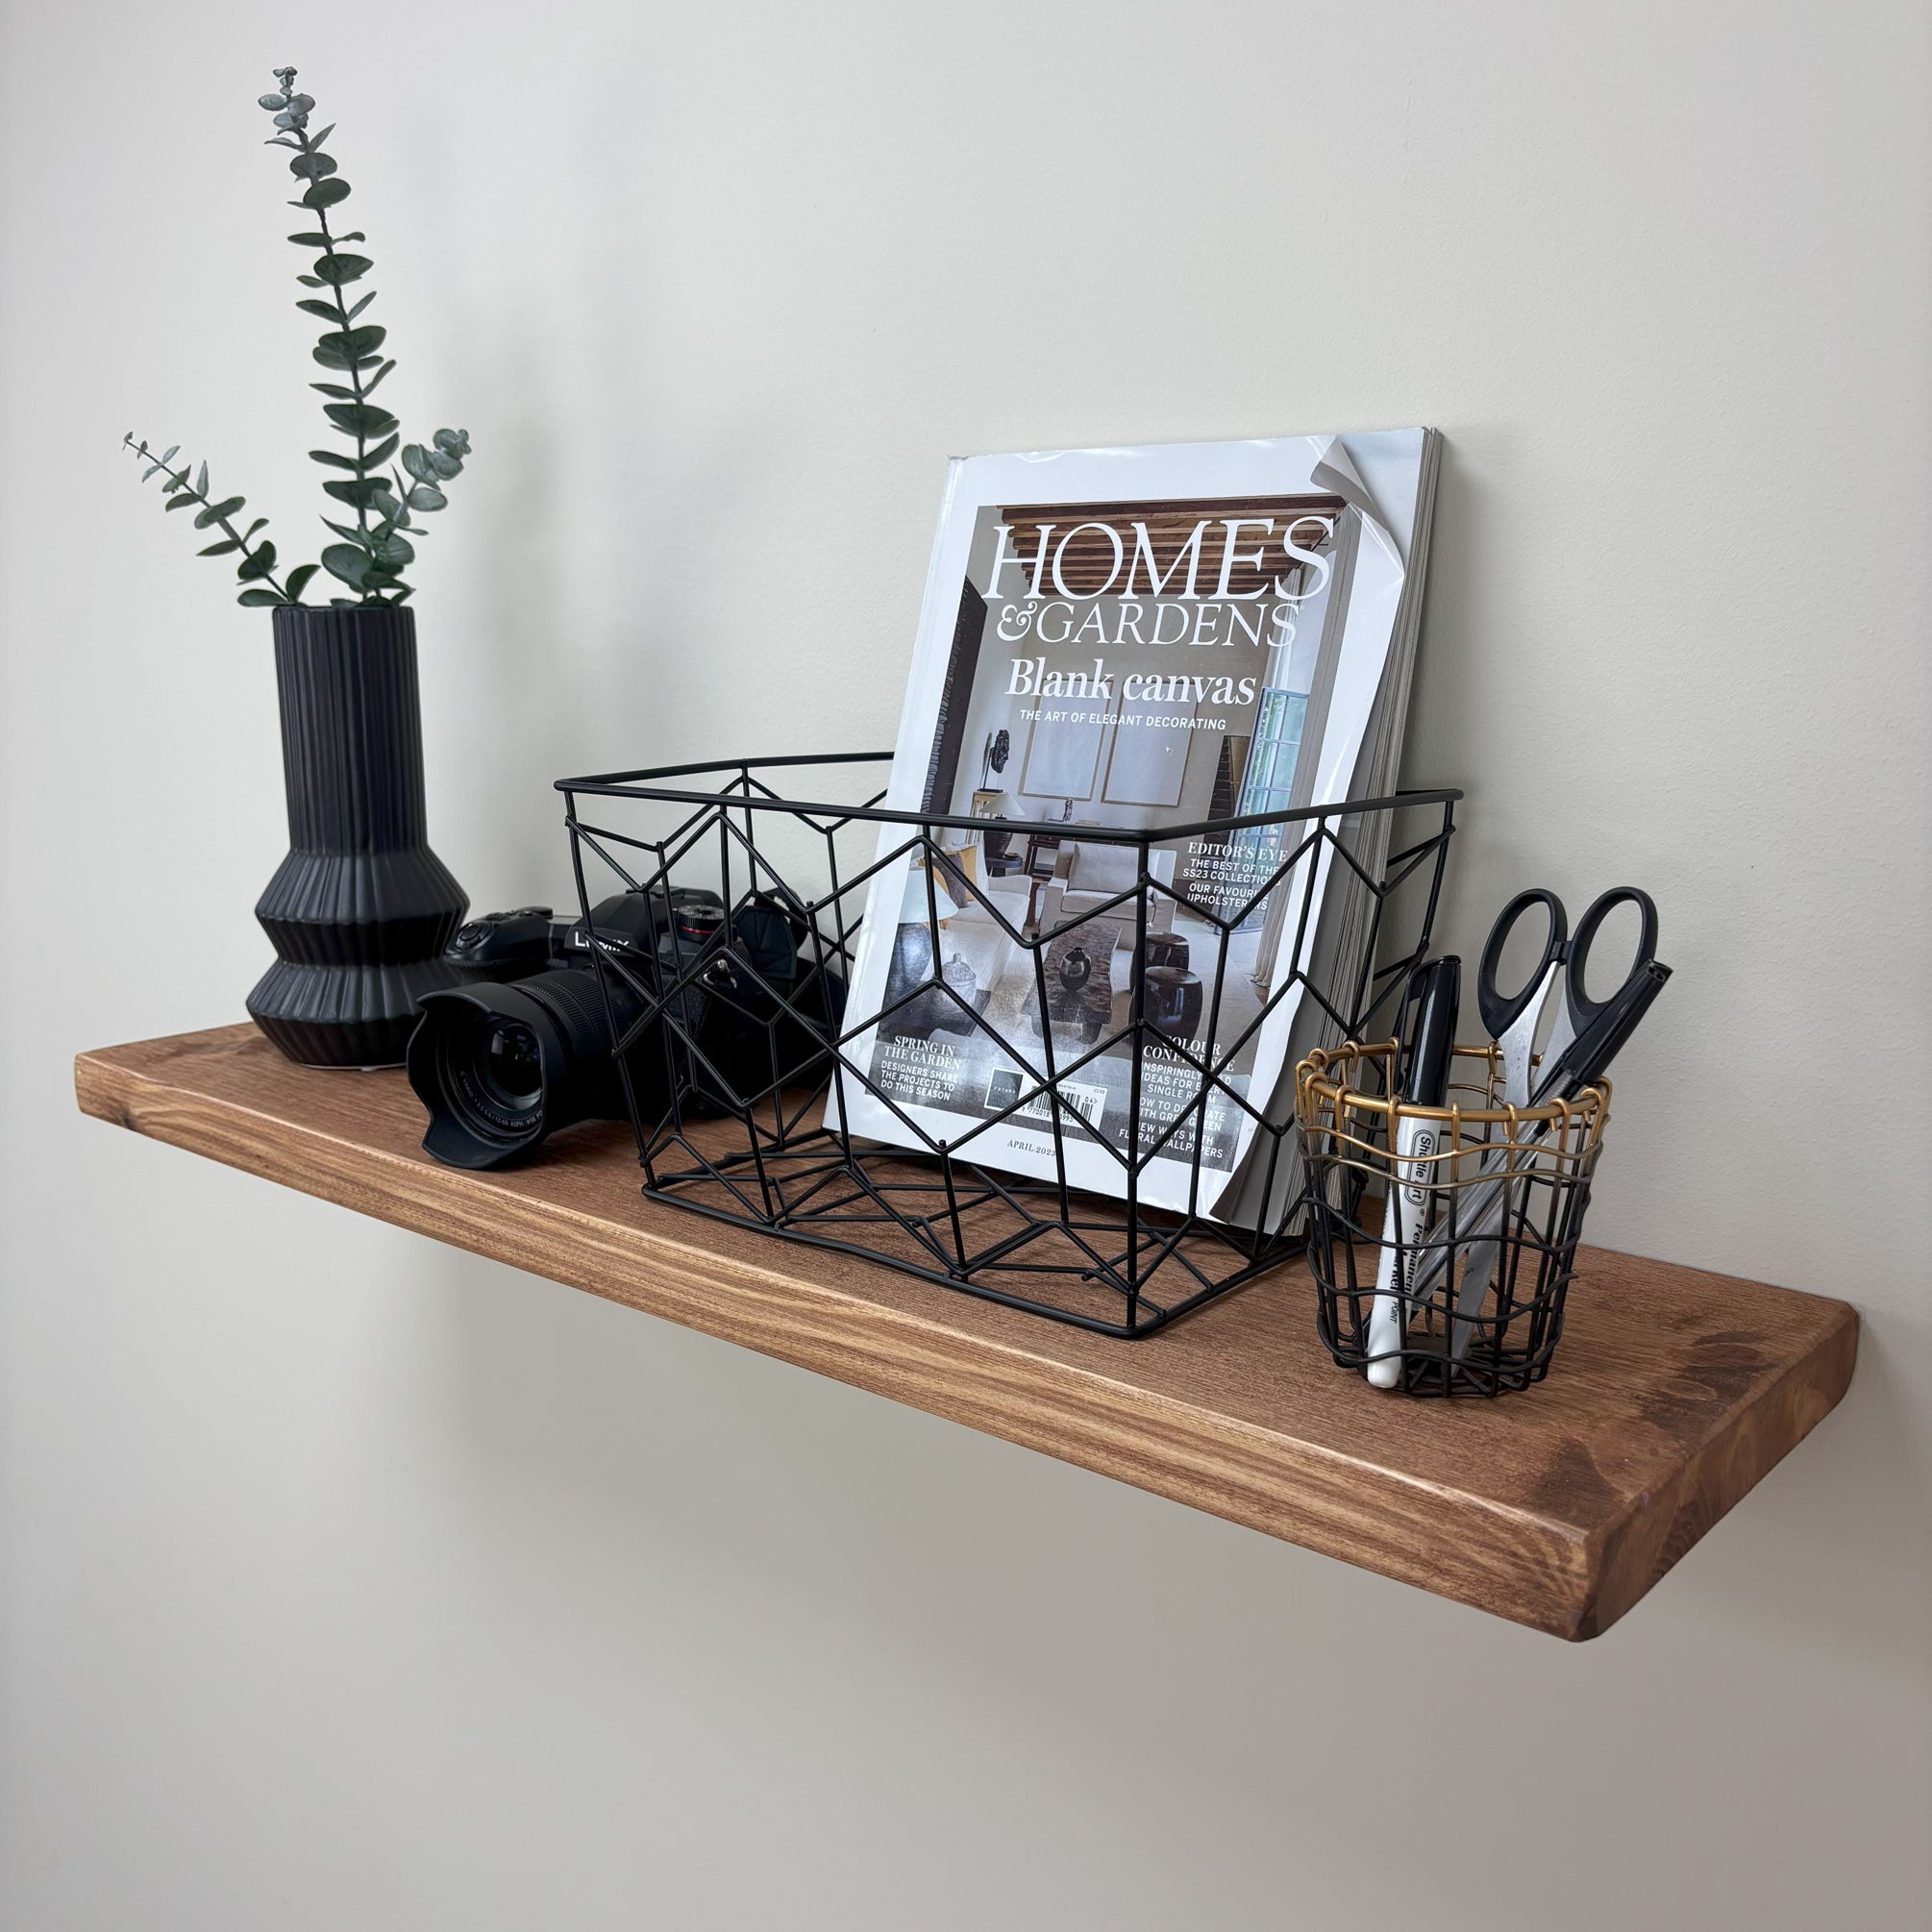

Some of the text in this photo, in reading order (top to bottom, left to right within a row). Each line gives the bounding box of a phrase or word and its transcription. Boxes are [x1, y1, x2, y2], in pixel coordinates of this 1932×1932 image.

[980, 515, 1334, 601] HOMES
[1004, 656, 1257, 706] Blank canvas
[1020, 709, 1226, 731] THE ART OF ELEGANT DECORATING
[1187, 841, 1288, 863] EDITOR'S EYE
[1182, 867, 1281, 886] SS23 COLLECTIO
[1190, 857, 1279, 876] THE BEST OF THE
[1187, 893, 1268, 910] UPHOLSTERS
[1189, 882, 1269, 901] OUR FAVOURI
[883, 1044, 962, 1071] THE GARDEN
[894, 1034, 955, 1057] SPRING IN
[1143, 1045, 1235, 1072] CONFDENE
[880, 1060, 959, 1084] DESIGNERS SHARE
[880, 1069, 955, 1092] THE PROJECTS TO
[880, 1079, 952, 1102] DO THIS SEASON
[1141, 1072, 1226, 1097] IDEAS FOR EER
[1147, 1083, 1216, 1104] SINGLE ROM
[1139, 1097, 1226, 1122] OW TO DEATE
[1139, 1108, 1156, 1119] ITH
[1188, 1117, 1222, 1132] GEEN
[1118, 1127, 1224, 1158] FLRAL ALLPERS
[1138, 1122, 1215, 1146] EW WYS WTH
[1006, 1139, 1056, 1157] APRIL 2023
[1412, 1136, 1432, 1200] Shtle rt
[1404, 1223, 1424, 1295] Peranen
